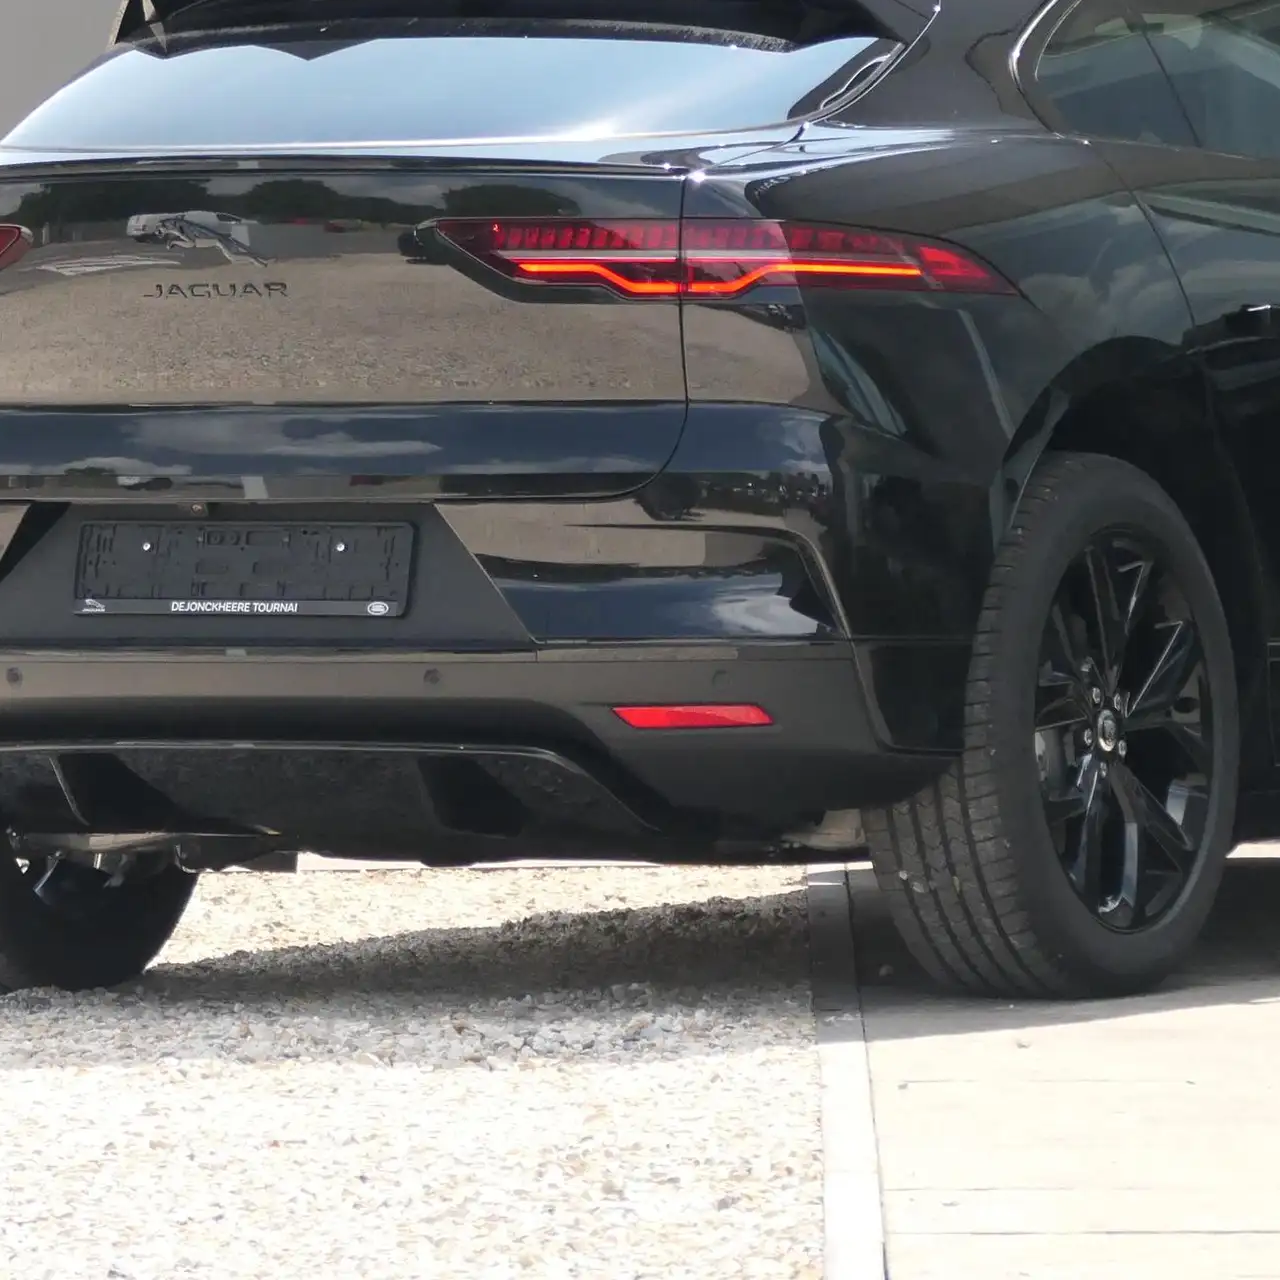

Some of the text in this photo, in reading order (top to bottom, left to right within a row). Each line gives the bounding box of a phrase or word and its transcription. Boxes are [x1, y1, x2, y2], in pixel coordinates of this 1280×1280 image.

[143, 282, 288, 299] JAGUAR
[171, 601, 298, 613] DEJONCKHEERE TOURNAI
